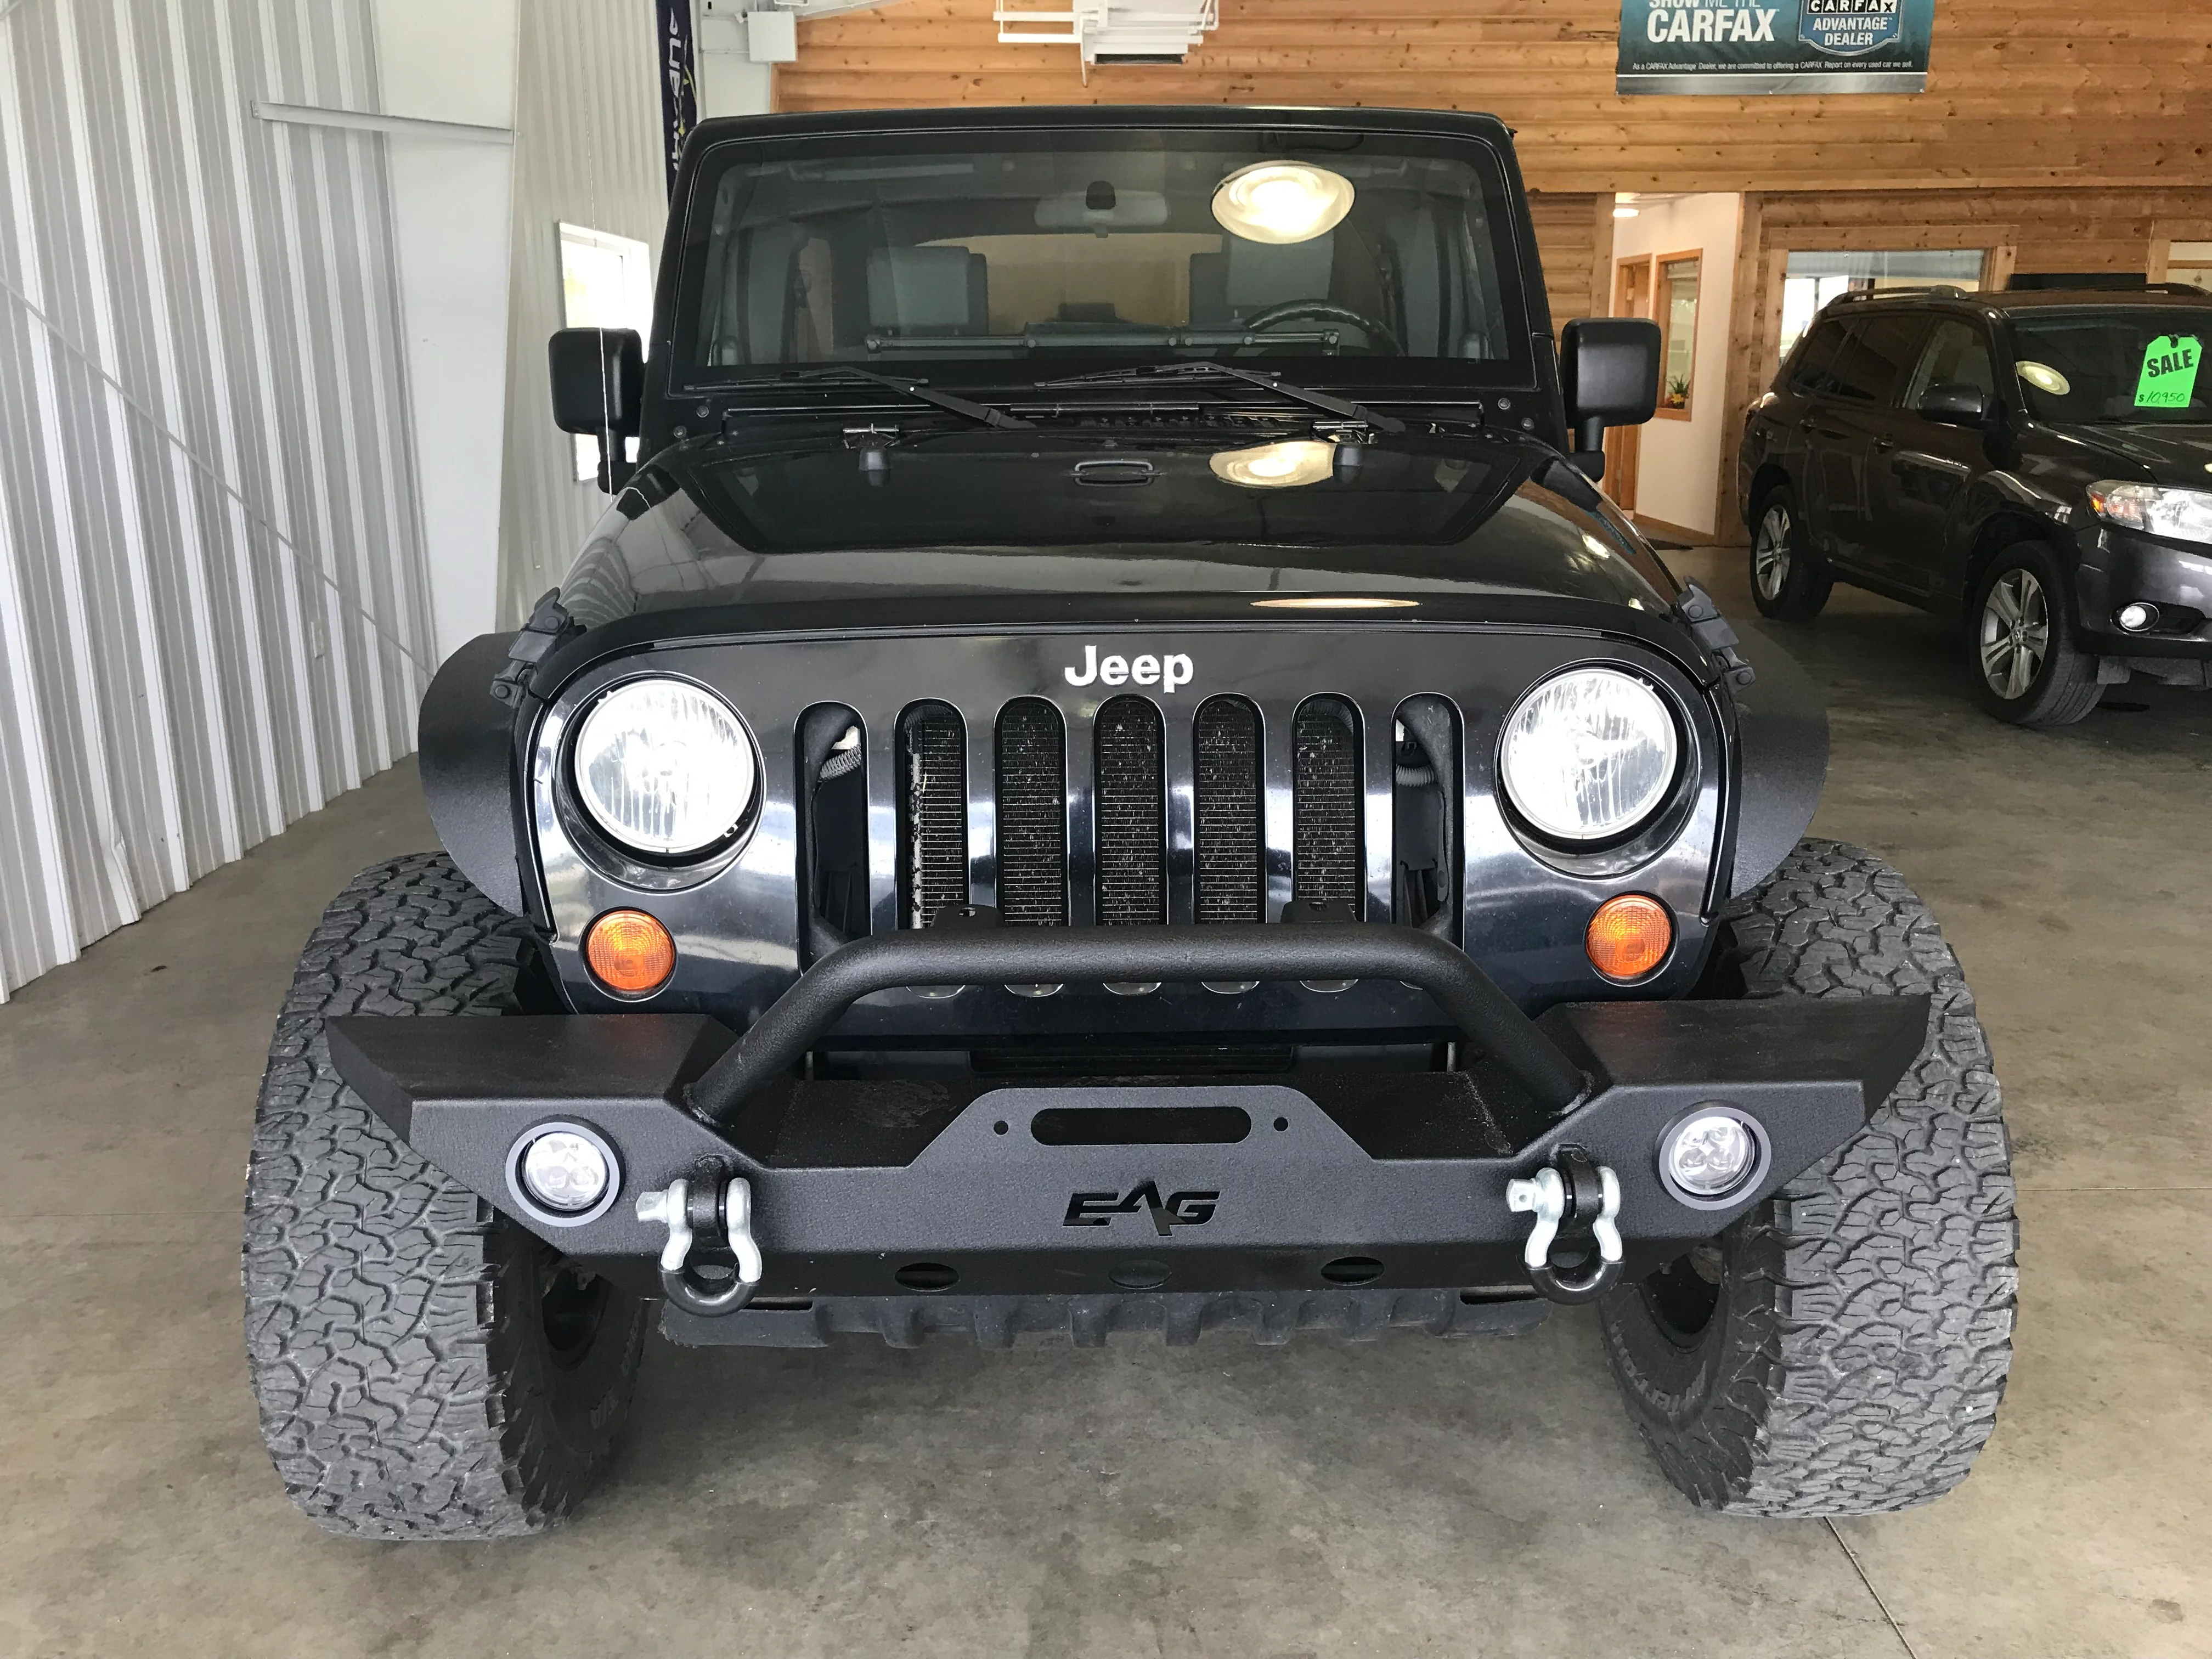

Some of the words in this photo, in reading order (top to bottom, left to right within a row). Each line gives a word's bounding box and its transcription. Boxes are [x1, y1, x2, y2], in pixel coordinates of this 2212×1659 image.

[1811, 0, 1893, 12] CARFAX
[1647, 8, 1776, 43] CARFAX
[1813, 17, 1888, 31] ADVANTAGE
[1824, 32, 1874, 46] DEALER
[1646, 62, 1668, 70] CARFAX
[2146, 349, 2194, 378] SALE
[1064, 645, 1194, 694] Jeep
[1062, 1180, 1221, 1237] EAG
